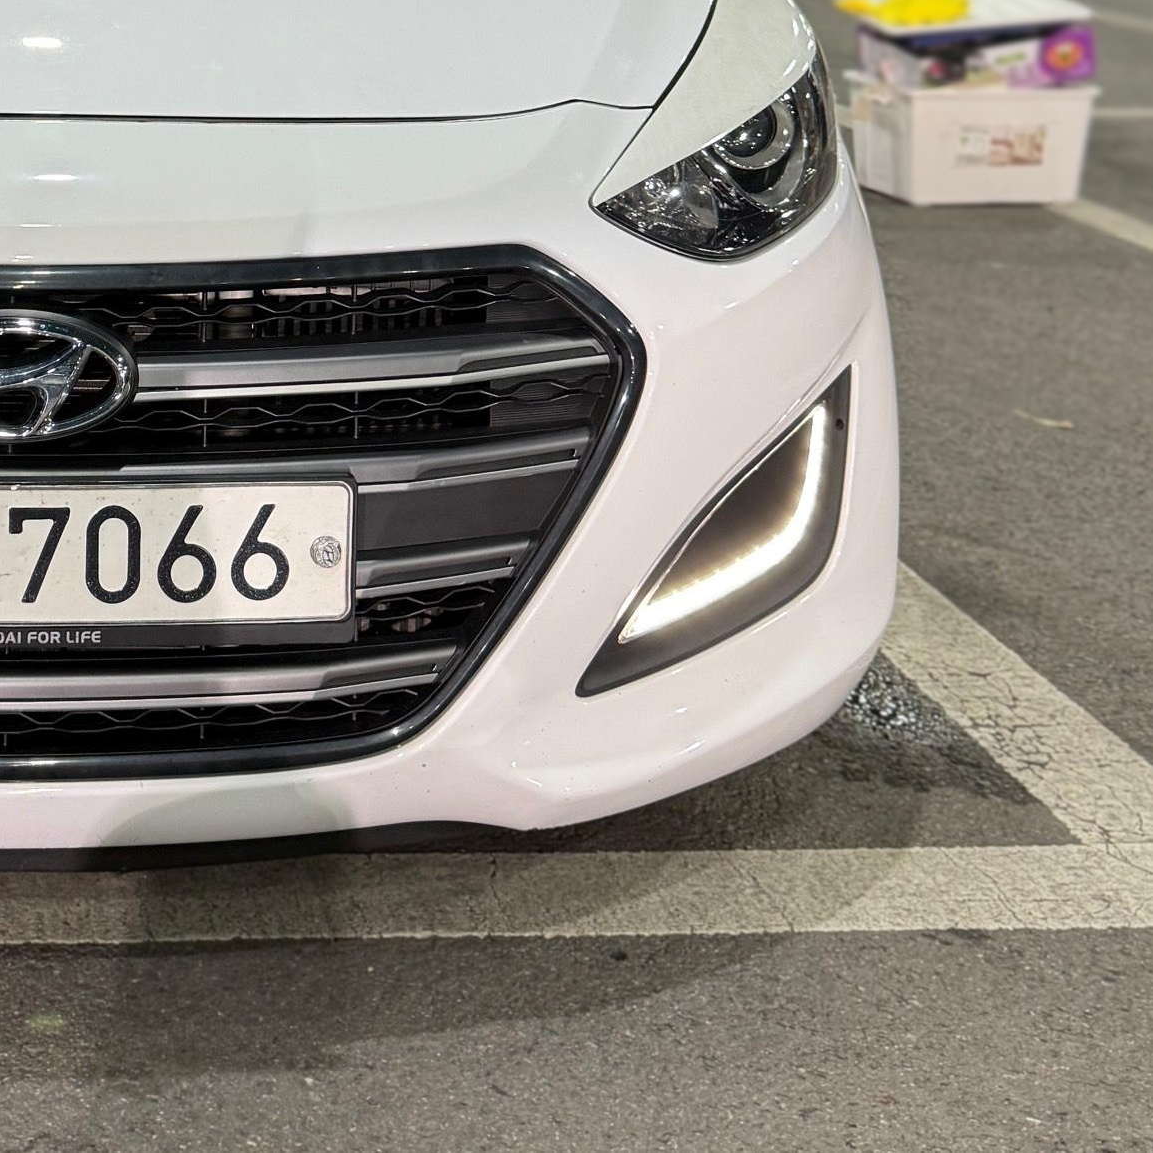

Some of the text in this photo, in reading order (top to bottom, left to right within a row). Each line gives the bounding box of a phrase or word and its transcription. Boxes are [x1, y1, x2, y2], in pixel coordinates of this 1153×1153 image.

[8, 503, 290, 604] 7066
[26, 631, 61, 644] FOR
[65, 630, 102, 644] LIFE
